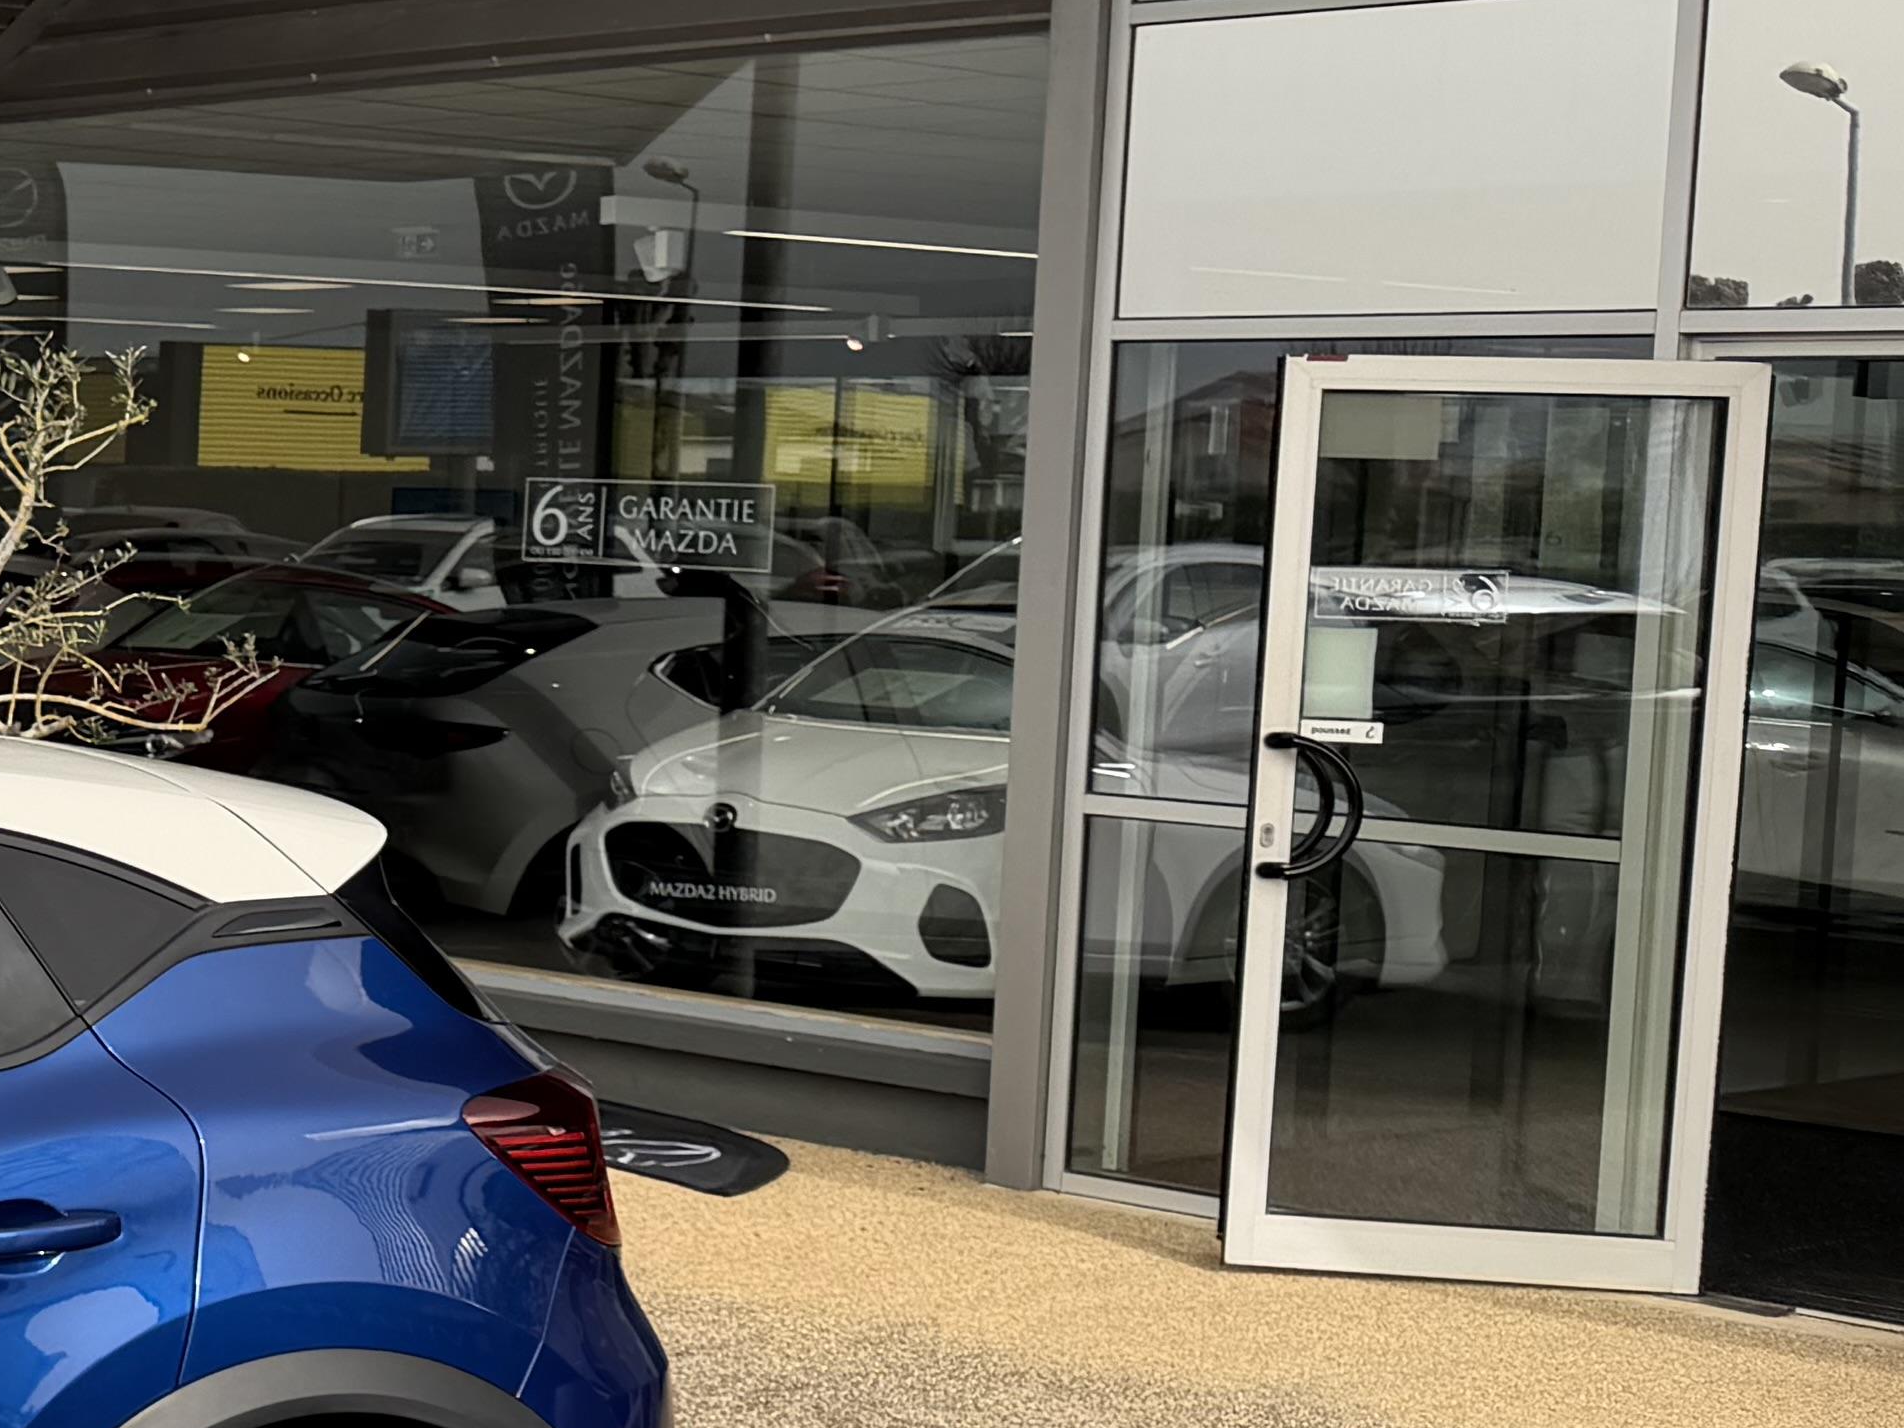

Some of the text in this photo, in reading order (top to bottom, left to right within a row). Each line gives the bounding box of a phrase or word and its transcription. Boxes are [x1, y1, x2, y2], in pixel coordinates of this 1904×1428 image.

[532, 485, 596, 546] 6 ANS
[619, 494, 755, 524] GARANTIE
[633, 528, 737, 555] MAZDA
[649, 881, 777, 904] MAZDA2 HYBRID
